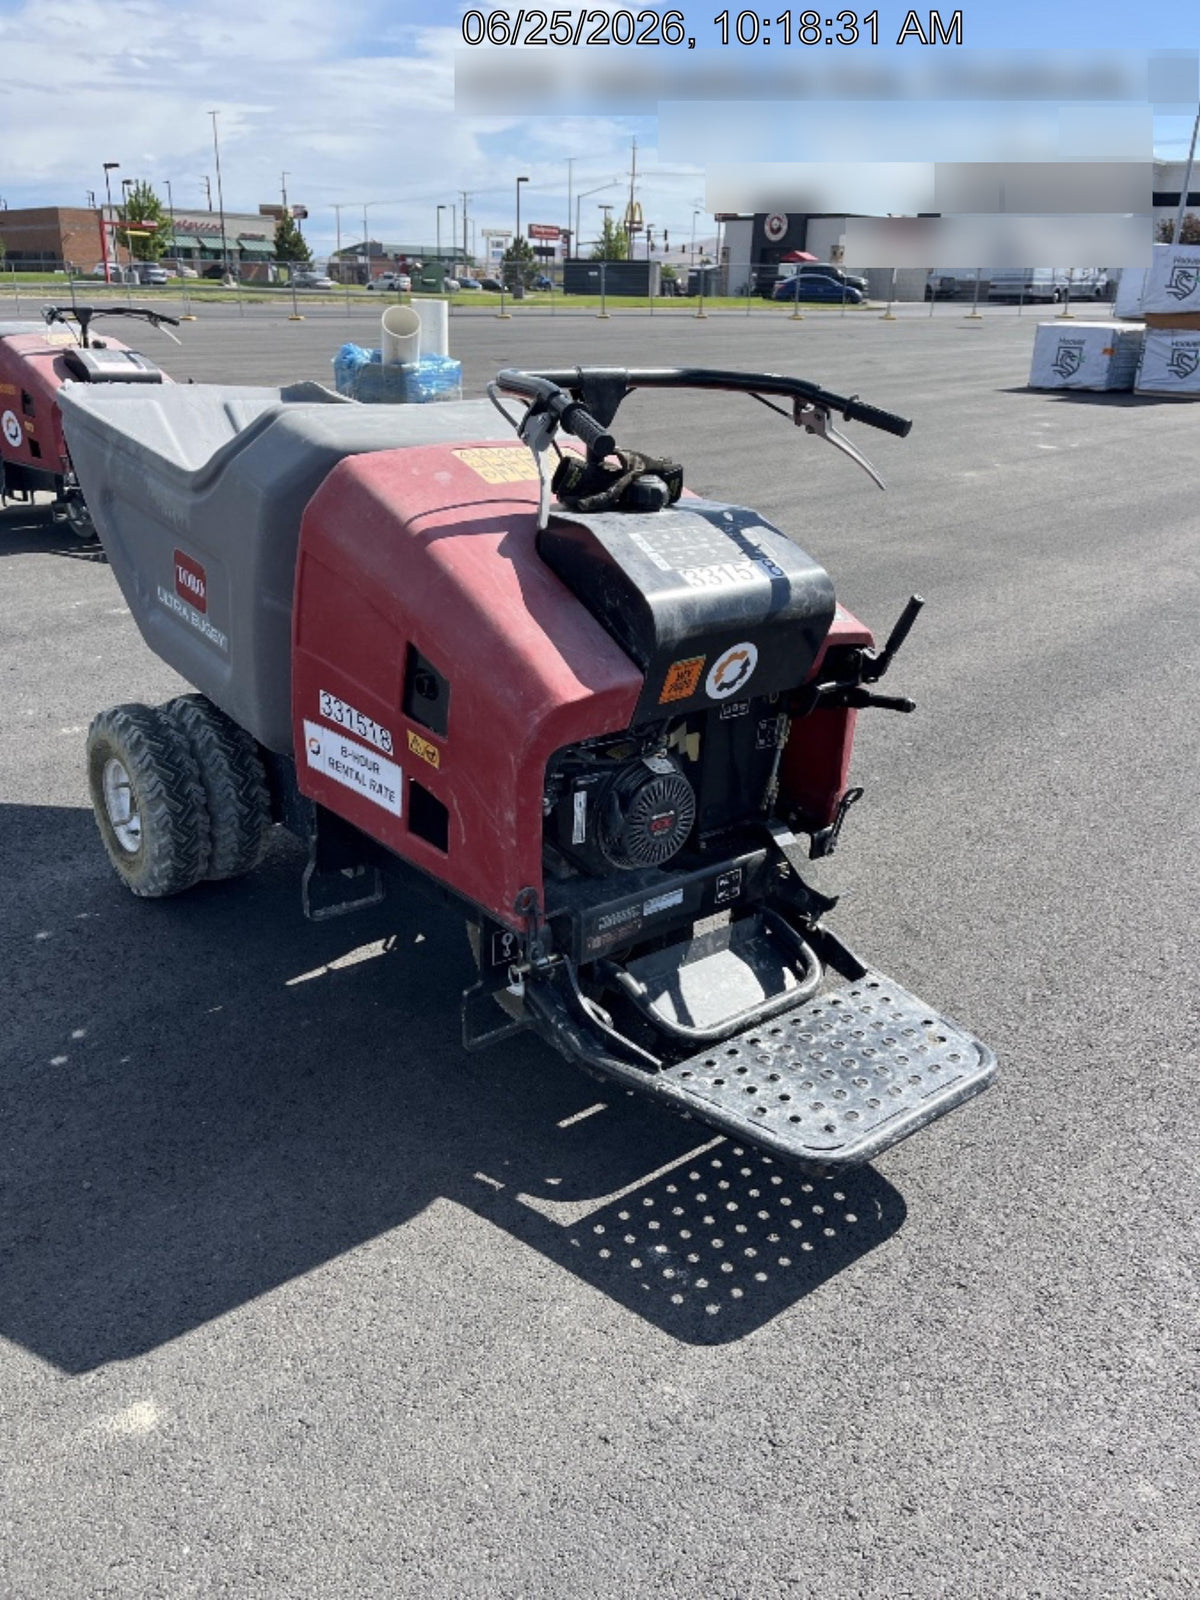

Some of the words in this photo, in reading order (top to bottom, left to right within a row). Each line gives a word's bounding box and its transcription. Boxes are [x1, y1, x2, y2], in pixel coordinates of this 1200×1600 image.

[682, 556, 785, 590] 33158
[320, 691, 393, 754] 331518
[327, 756, 367, 788] RENTAL
[368, 779, 396, 804] RATE
[340, 745, 380, 775] 8-HOUR
